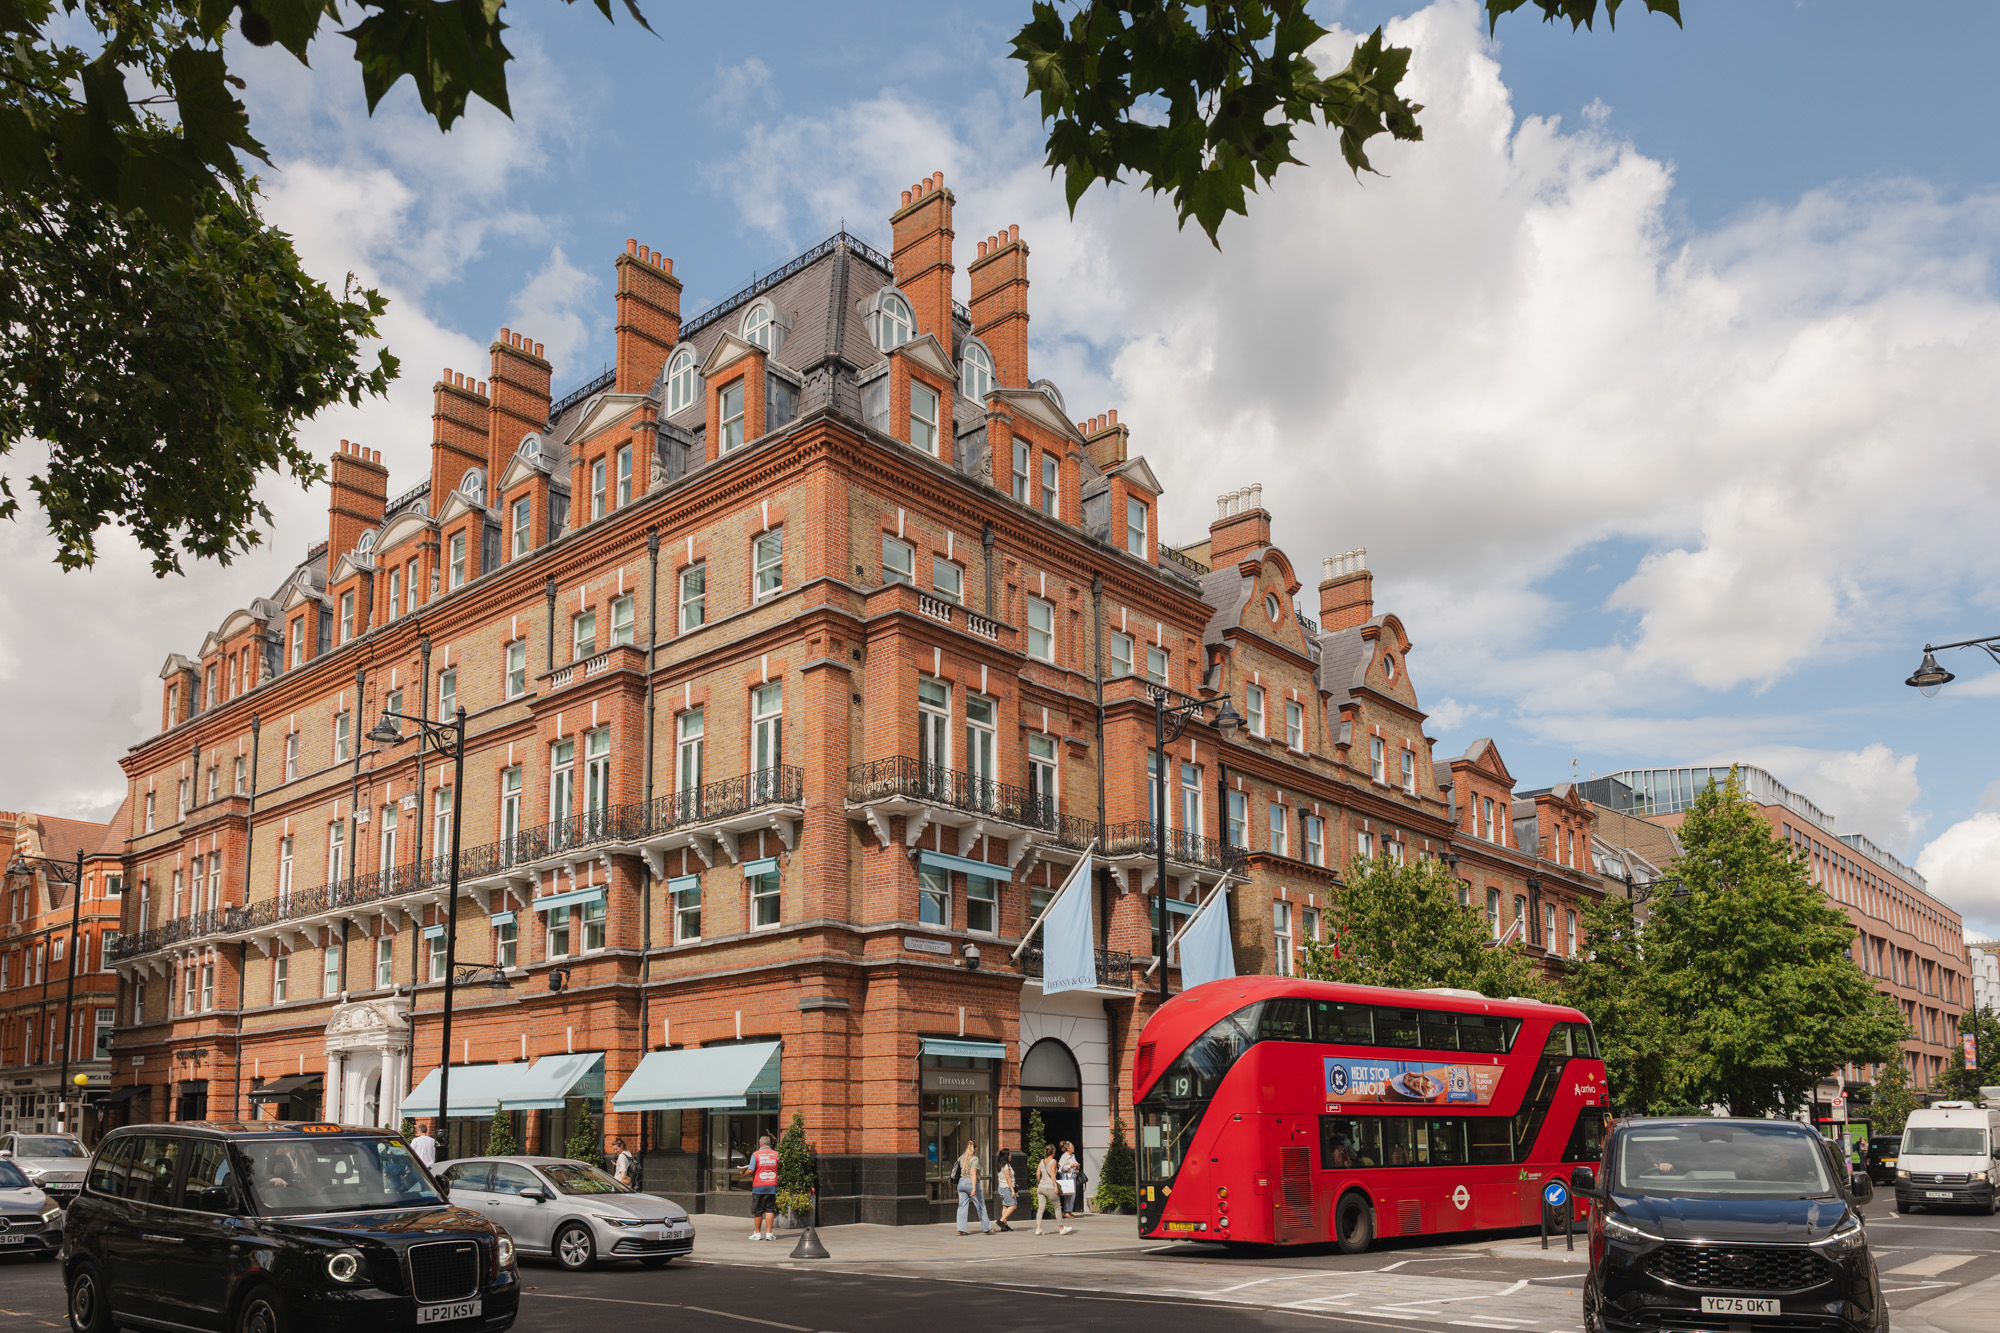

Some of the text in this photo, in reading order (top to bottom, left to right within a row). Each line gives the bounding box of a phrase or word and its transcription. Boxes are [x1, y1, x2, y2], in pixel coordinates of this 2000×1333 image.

[905, 941, 923, 949] SLOANE
[1047, 978, 1071, 989] TIFFANY
[1351, 1066, 1391, 1081] NEXT STOP,
[938, 1076, 961, 1085] TIFFANY
[1175, 1077, 1189, 1096] 19
[1352, 1081, 1386, 1096] FLAVOUR
[1580, 1085, 1596, 1094] arriva
[1035, 1095, 1053, 1103] TIFFANY
[7, 1235, 23, 1243] GYU
[1707, 1298, 1774, 1313] YC75 OKT
[424, 1303, 475, 1322] LP21 KSV
